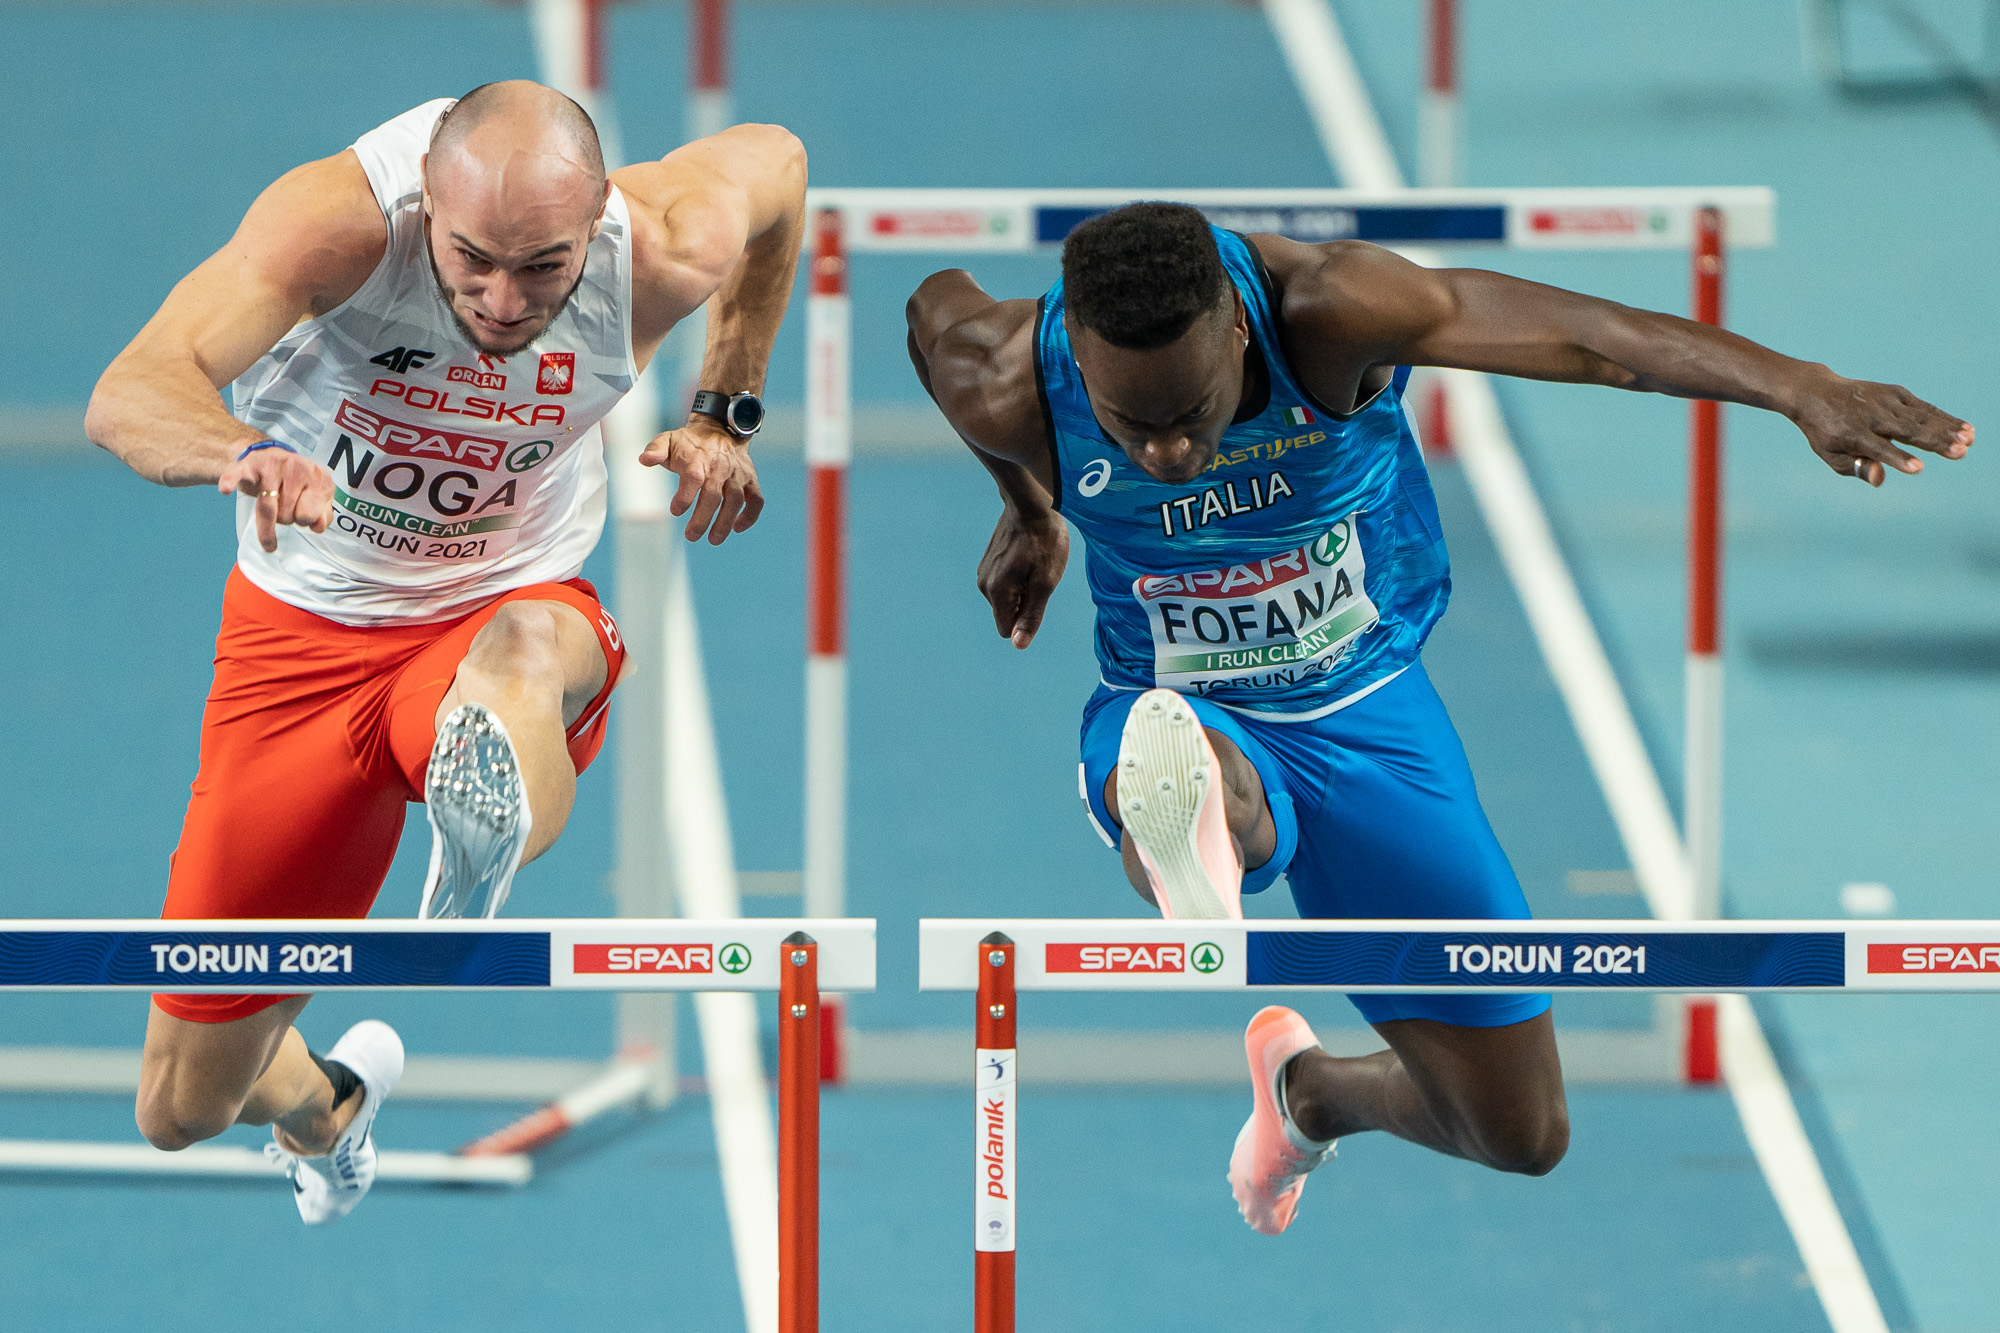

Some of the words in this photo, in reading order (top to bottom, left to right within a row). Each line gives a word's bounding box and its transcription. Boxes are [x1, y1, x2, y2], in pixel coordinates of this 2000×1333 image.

[369, 346, 436, 375] 4F
[542, 354, 573, 362] POLSKA
[450, 368, 503, 389] ORLEN
[369, 379, 566, 427] POLSKA
[340, 405, 500, 467] SPAR
[1202, 430, 1327, 473] ASTWEB
[327, 433, 518, 518] NOGA
[344, 497, 351, 508] I
[354, 501, 400, 525] RUN
[1160, 471, 1295, 537] ITALIA
[424, 539, 488, 559] 2021
[1143, 548, 1303, 597] SPAR
[1158, 568, 1354, 645] FOFANA
[1206, 655, 1212, 669] I
[1218, 649, 1263, 668] RUN
[150, 944, 269, 974] TORUN
[279, 944, 353, 974] 2021
[607, 947, 712, 971] SPAR
[1079, 946, 1183, 970] SPAR
[1444, 944, 1562, 974] TORUN
[1572, 944, 1646, 974] 2021
[983, 1098, 1009, 1200] polanik
